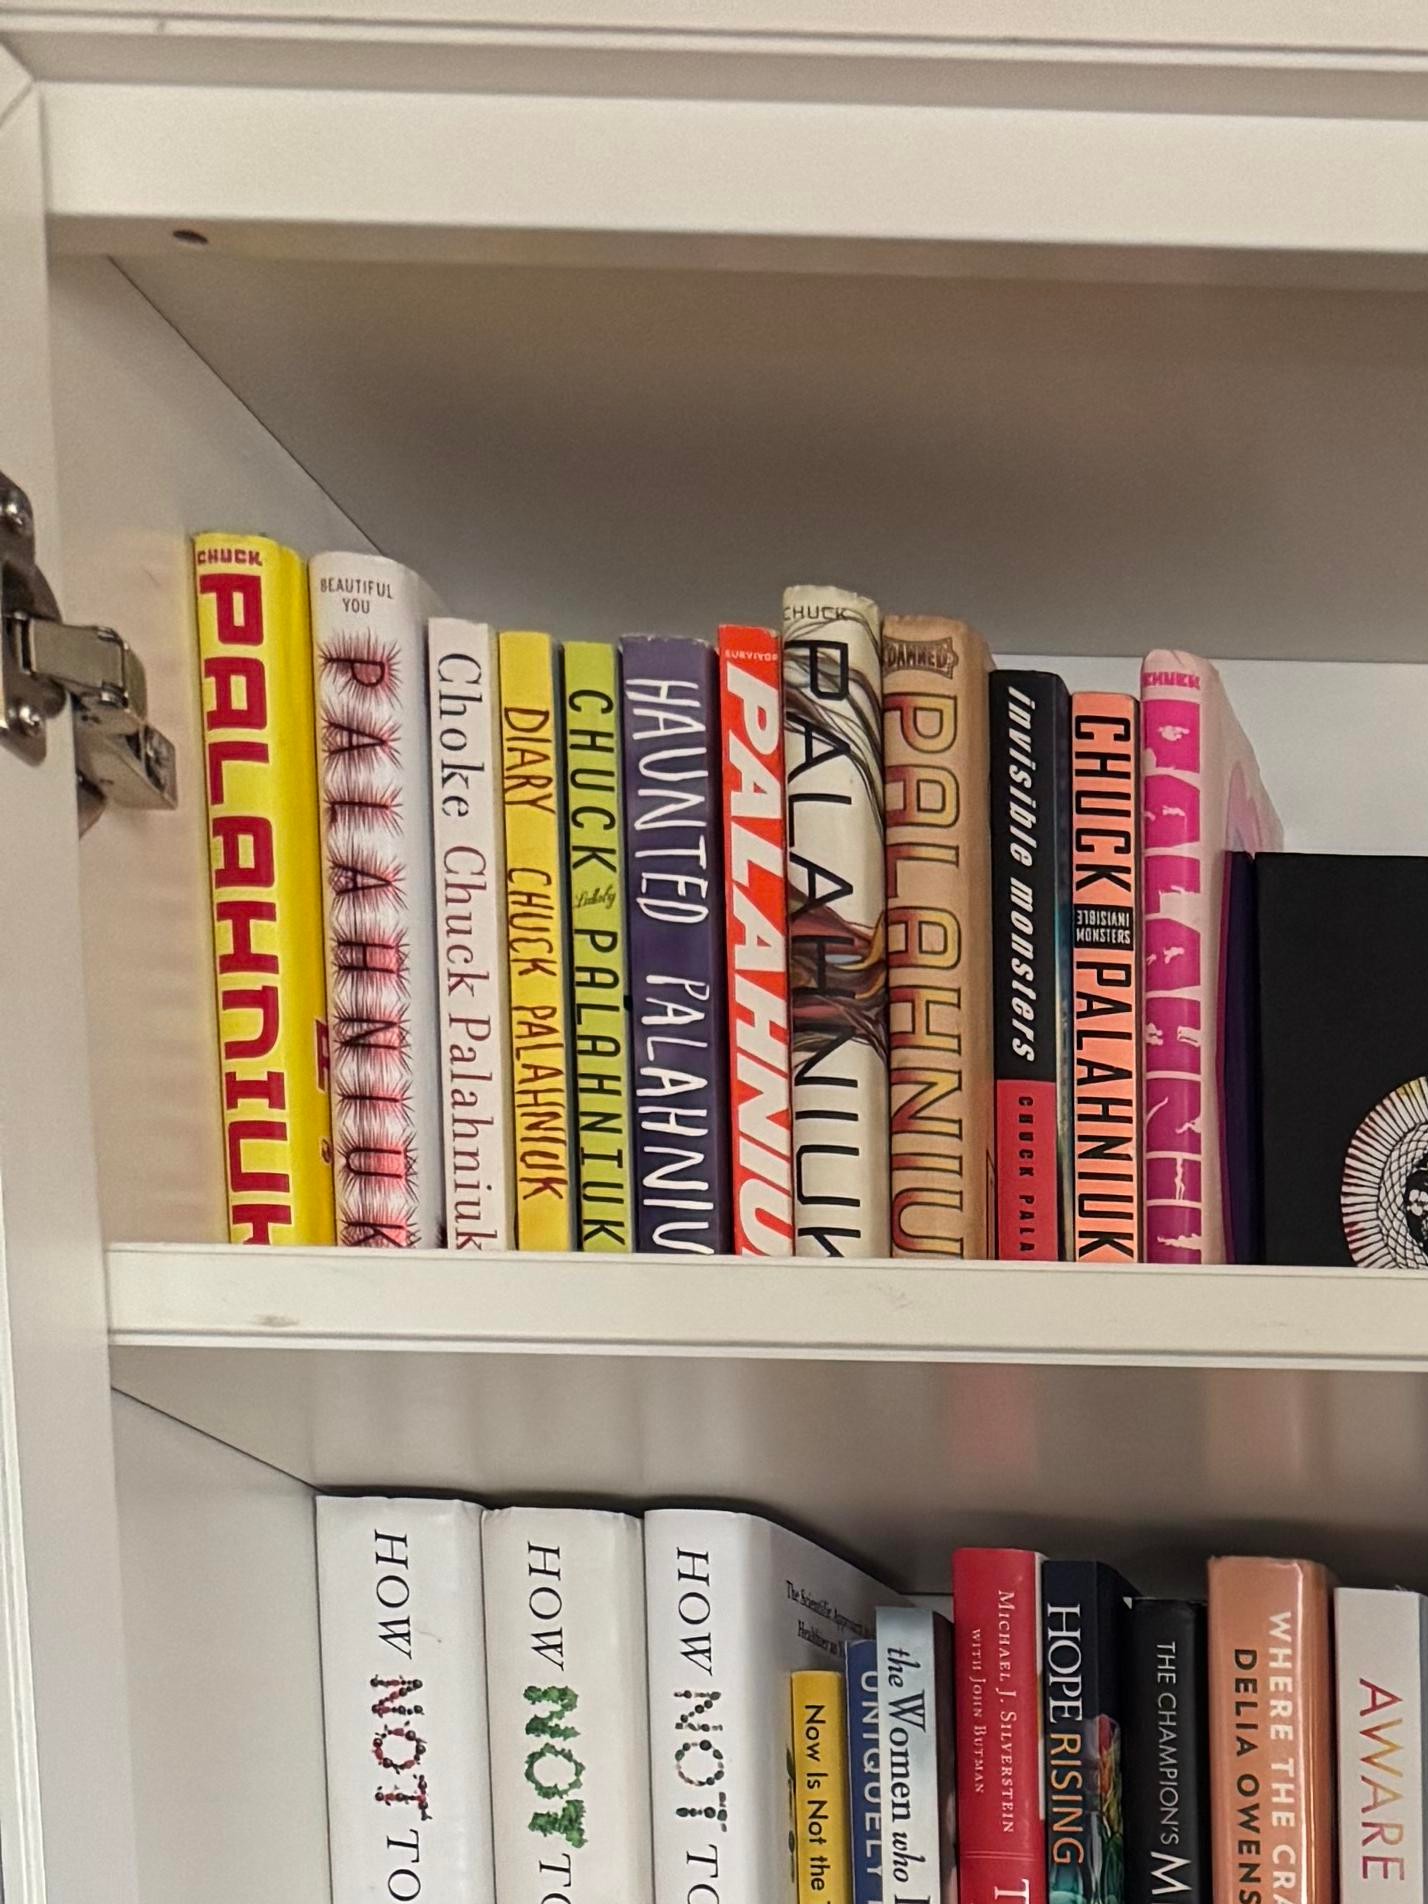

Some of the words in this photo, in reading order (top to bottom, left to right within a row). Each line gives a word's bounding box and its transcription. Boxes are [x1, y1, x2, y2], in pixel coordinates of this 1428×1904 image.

[195, 549, 262, 566] CHUCK
[320, 579, 393, 599] BEAUTIFUL
[341, 597, 371, 614] YOU
[436, 651, 484, 819] Choke
[503, 707, 552, 816] DIARY
[1004, 686, 1035, 876] invisible
[443, 849, 489, 999] Chuck
[508, 867, 552, 978] CHUCK
[1008, 885, 1039, 1059] monsters
[1076, 909, 1130, 927] INVISIBLE
[1076, 928, 1130, 946] MONSTERS
[446, 1010, 496, 1249] Palahniuk
[514, 1003, 563, 1201] PALAHNIUK
[1233, 1648, 1257, 1760] DELIA
[1359, 1678, 1405, 1882] AWARE
